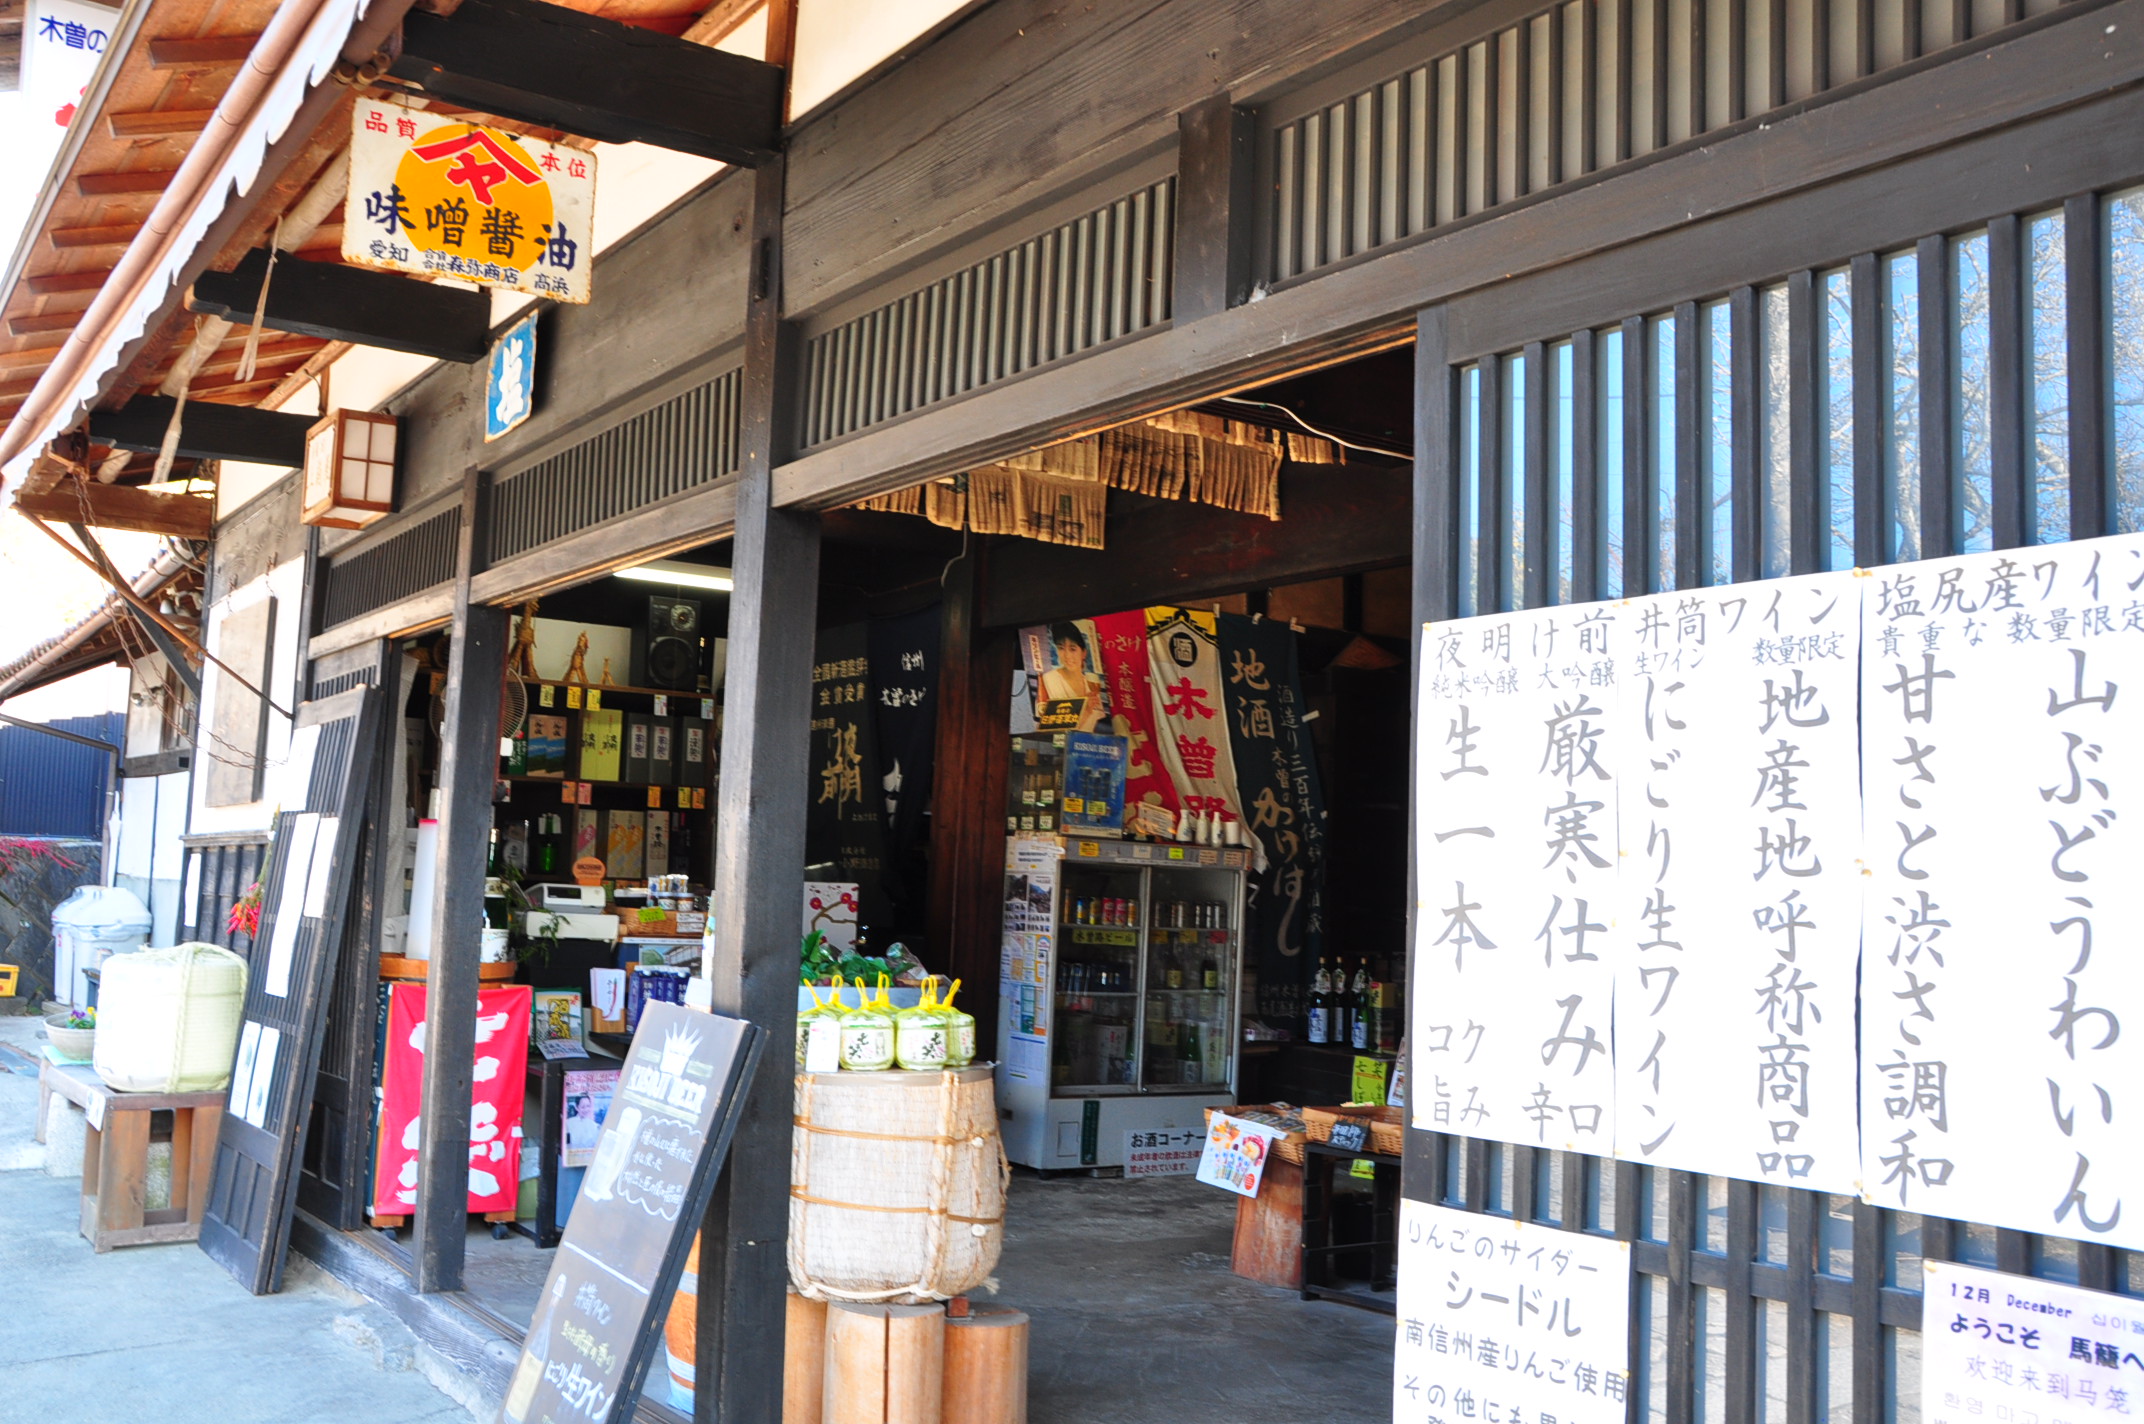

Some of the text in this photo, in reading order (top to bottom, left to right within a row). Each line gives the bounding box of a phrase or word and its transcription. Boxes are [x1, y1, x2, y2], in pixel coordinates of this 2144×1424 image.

[39, 15, 108, 53] 木曽の
[365, 110, 588, 180] 品質 本位
[369, 238, 409, 263] 愛知
[1435, 606, 1616, 672] 夜明け前
[1634, 588, 1839, 650] 井筒ワイン
[1752, 630, 1846, 667] 数量限定
[1431, 657, 1616, 700] 純米吟醸 大吟醸
[1633, 647, 1705, 677] 生ワイン
[1230, 648, 1276, 740] 地酒
[1431, 704, 1498, 974] 生一本
[1534, 694, 1613, 1077] 厳寒仕み
[1635, 675, 1688, 1157] にごり生ワイン
[1750, 669, 1830, 1179] 地産地呼称商品
[1874, 652, 1956, 1208] 甘さと渋さ調和
[2039, 648, 2121, 1234] 山ぶどうわいん
[1428, 1018, 1486, 1064] コク
[1433, 1075, 1491, 1128] 旨み
[1522, 1082, 1603, 1143] 辛口
[1131, 1130, 1206, 1148] お酒コーナー
[1408, 1218, 1599, 1277] りんごのサイダー
[1446, 1270, 1582, 1338] シードル
[1949, 1313, 2041, 1350] ようこそ
[2006, 1293, 2073, 1319] December
[1404, 1317, 1627, 1404] 南信州産りんご使用
